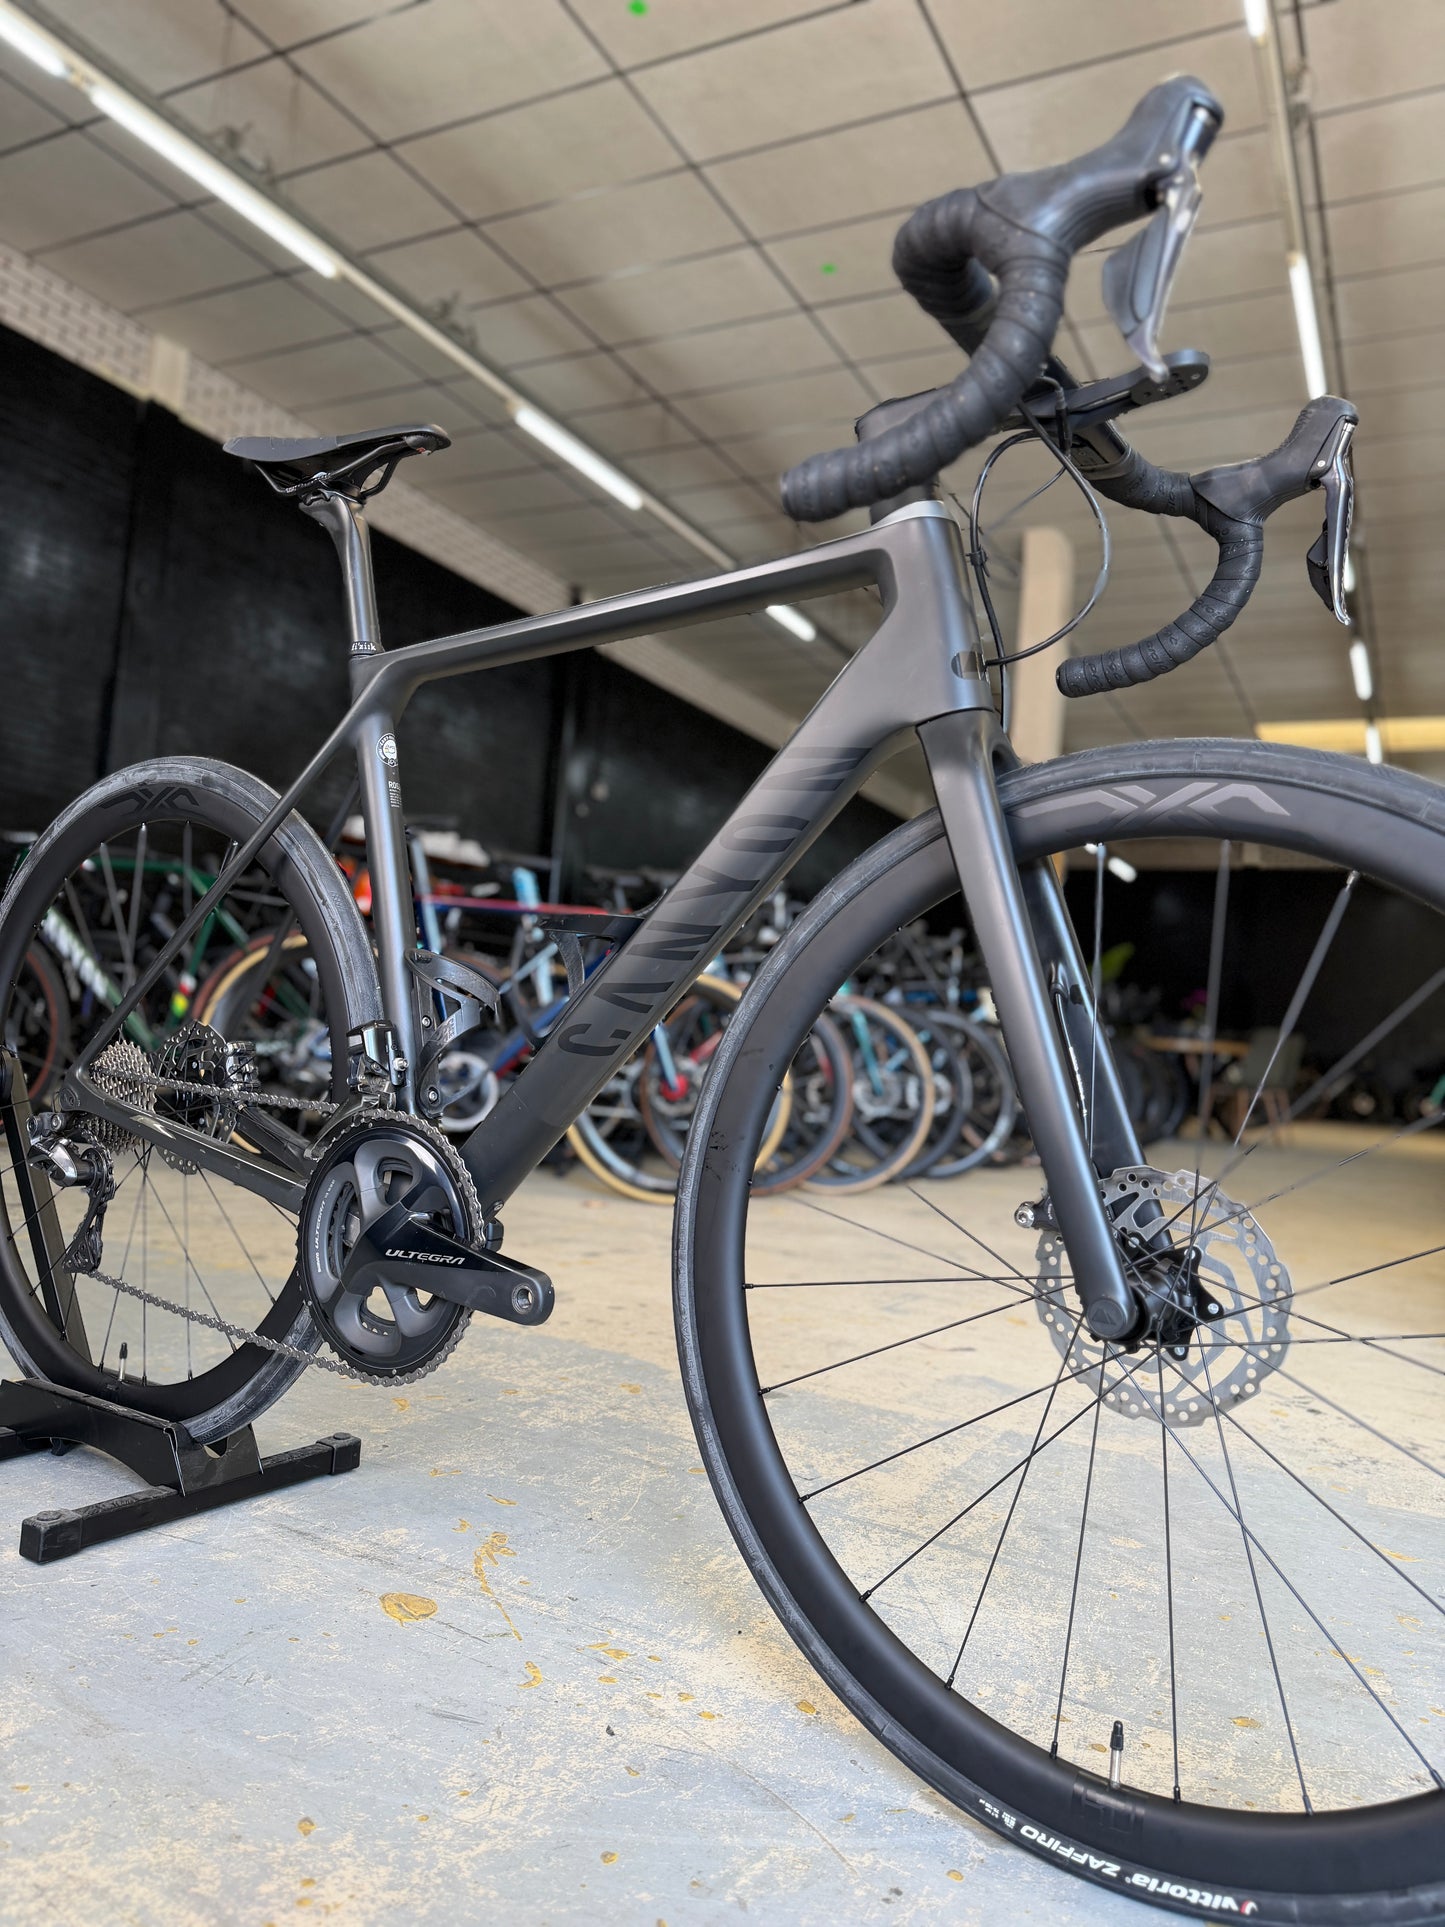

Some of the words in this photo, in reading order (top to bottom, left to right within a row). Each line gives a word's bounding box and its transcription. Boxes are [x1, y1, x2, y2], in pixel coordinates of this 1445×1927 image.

[557, 747, 873, 1058] CANYON
[385, 1248, 466, 1265] ULTEGRA
[1020, 1824, 1121, 1877] ZAFFIRO
